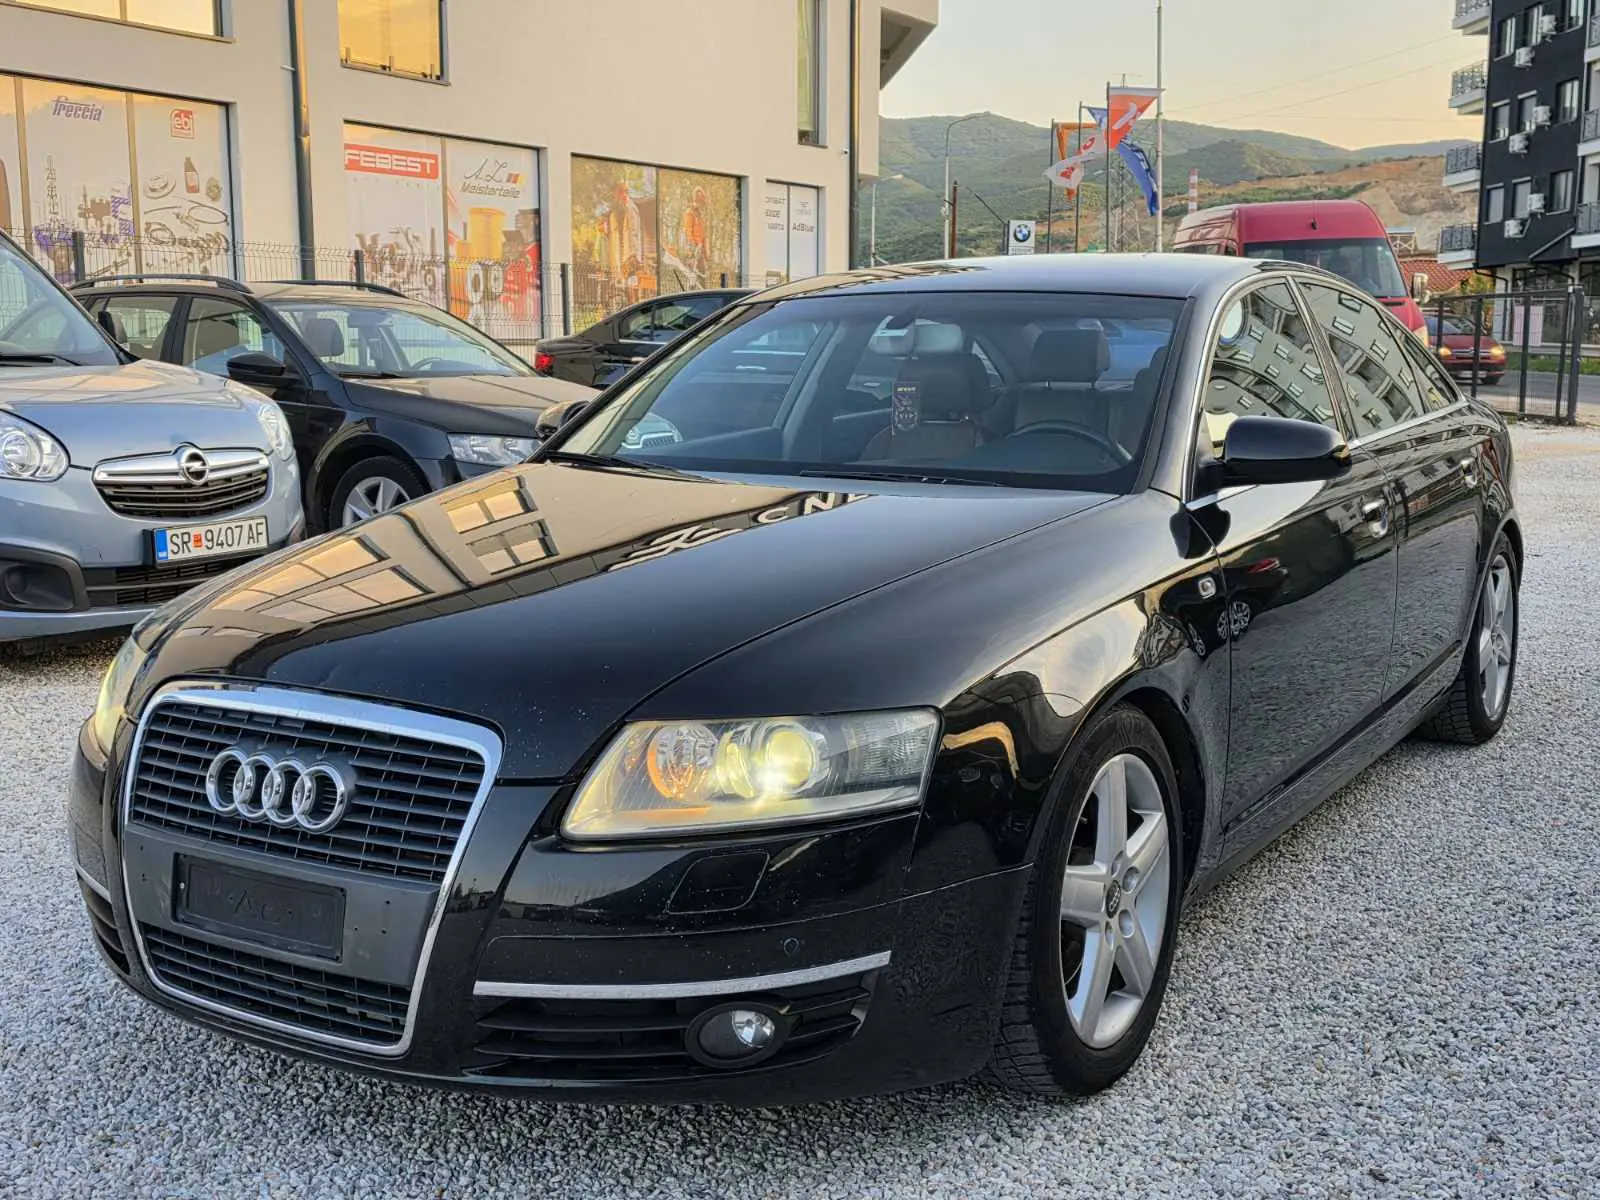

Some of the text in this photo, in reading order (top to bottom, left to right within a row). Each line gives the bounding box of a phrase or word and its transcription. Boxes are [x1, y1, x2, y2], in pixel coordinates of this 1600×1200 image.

[344, 150, 436, 173] FEBEST
[169, 531, 191, 555] SR
[204, 524, 243, 550] 9407
[247, 521, 264, 545] AF
